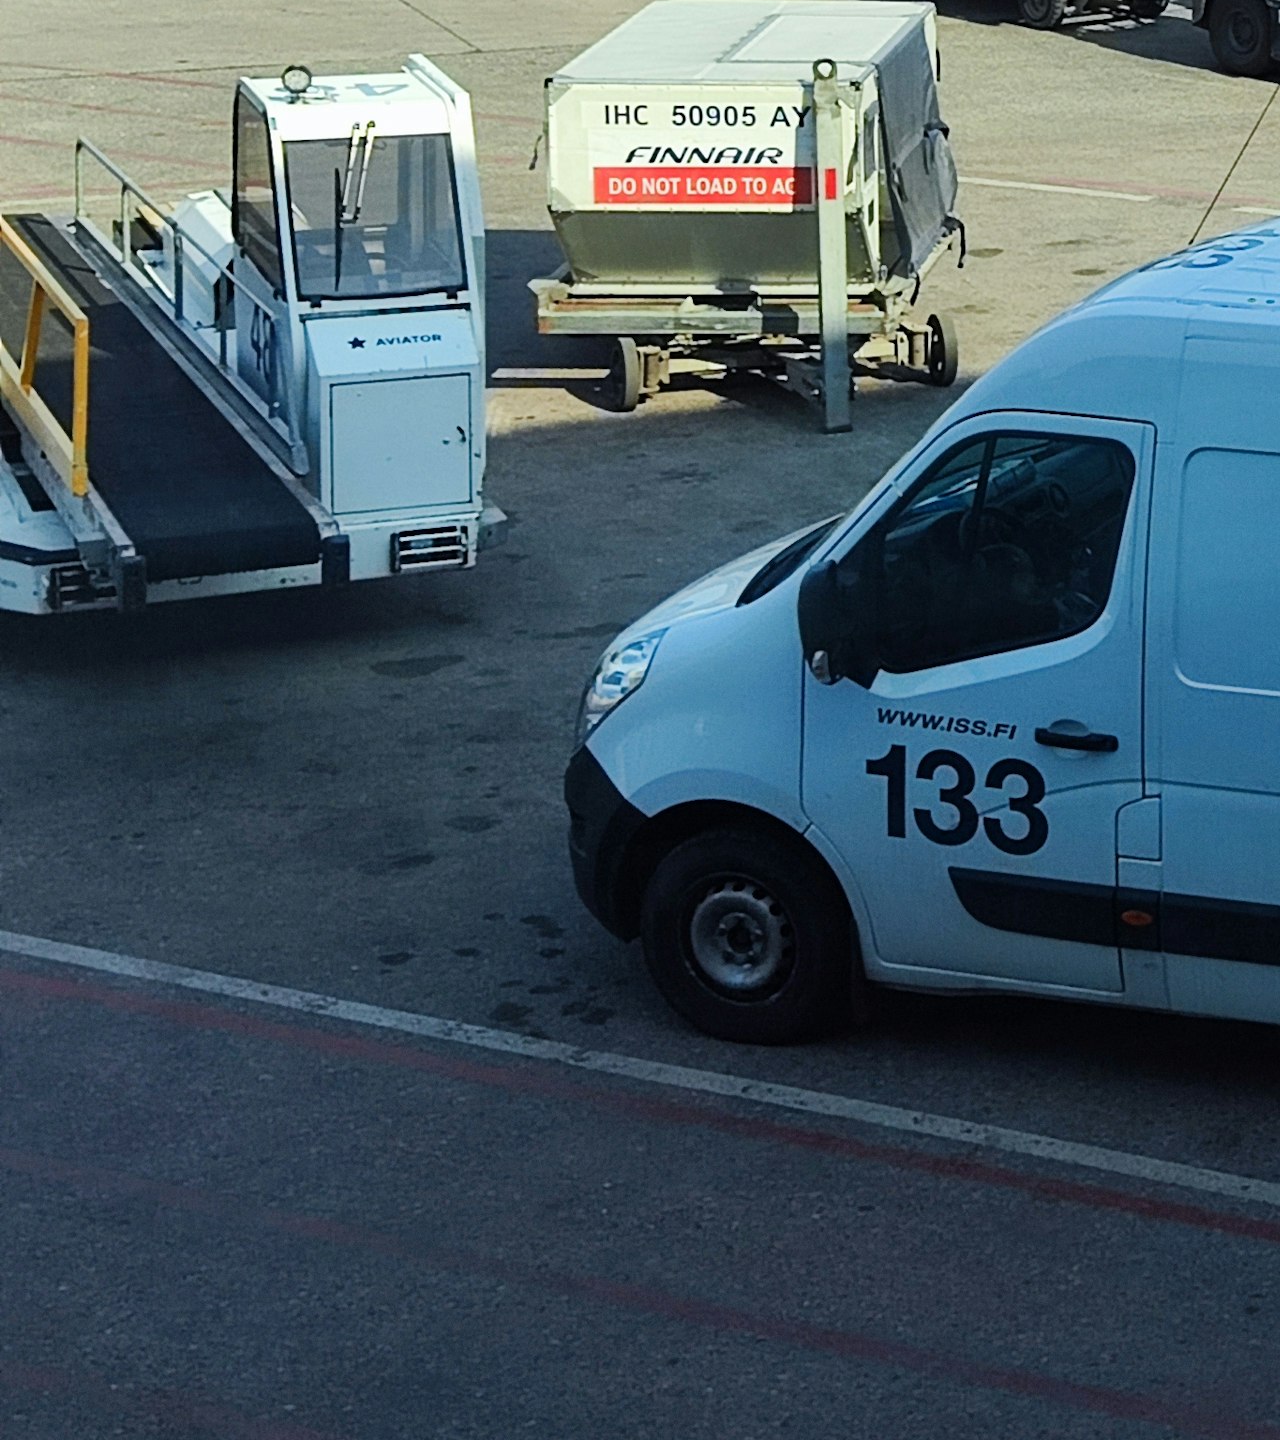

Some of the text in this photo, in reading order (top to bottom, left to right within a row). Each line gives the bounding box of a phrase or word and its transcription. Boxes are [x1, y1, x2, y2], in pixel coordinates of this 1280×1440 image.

[603, 104, 812, 128] IHC 50905 AY
[625, 146, 783, 164] FINNAIR
[608, 177, 637, 195] DO
[642, 177, 681, 196] NOT
[686, 177, 736, 196] LOAD
[741, 178, 766, 196] TO
[375, 333, 442, 347] AVIATOR
[877, 708, 1017, 740] WWW.ISS.FI
[866, 743, 1050, 856] 133
